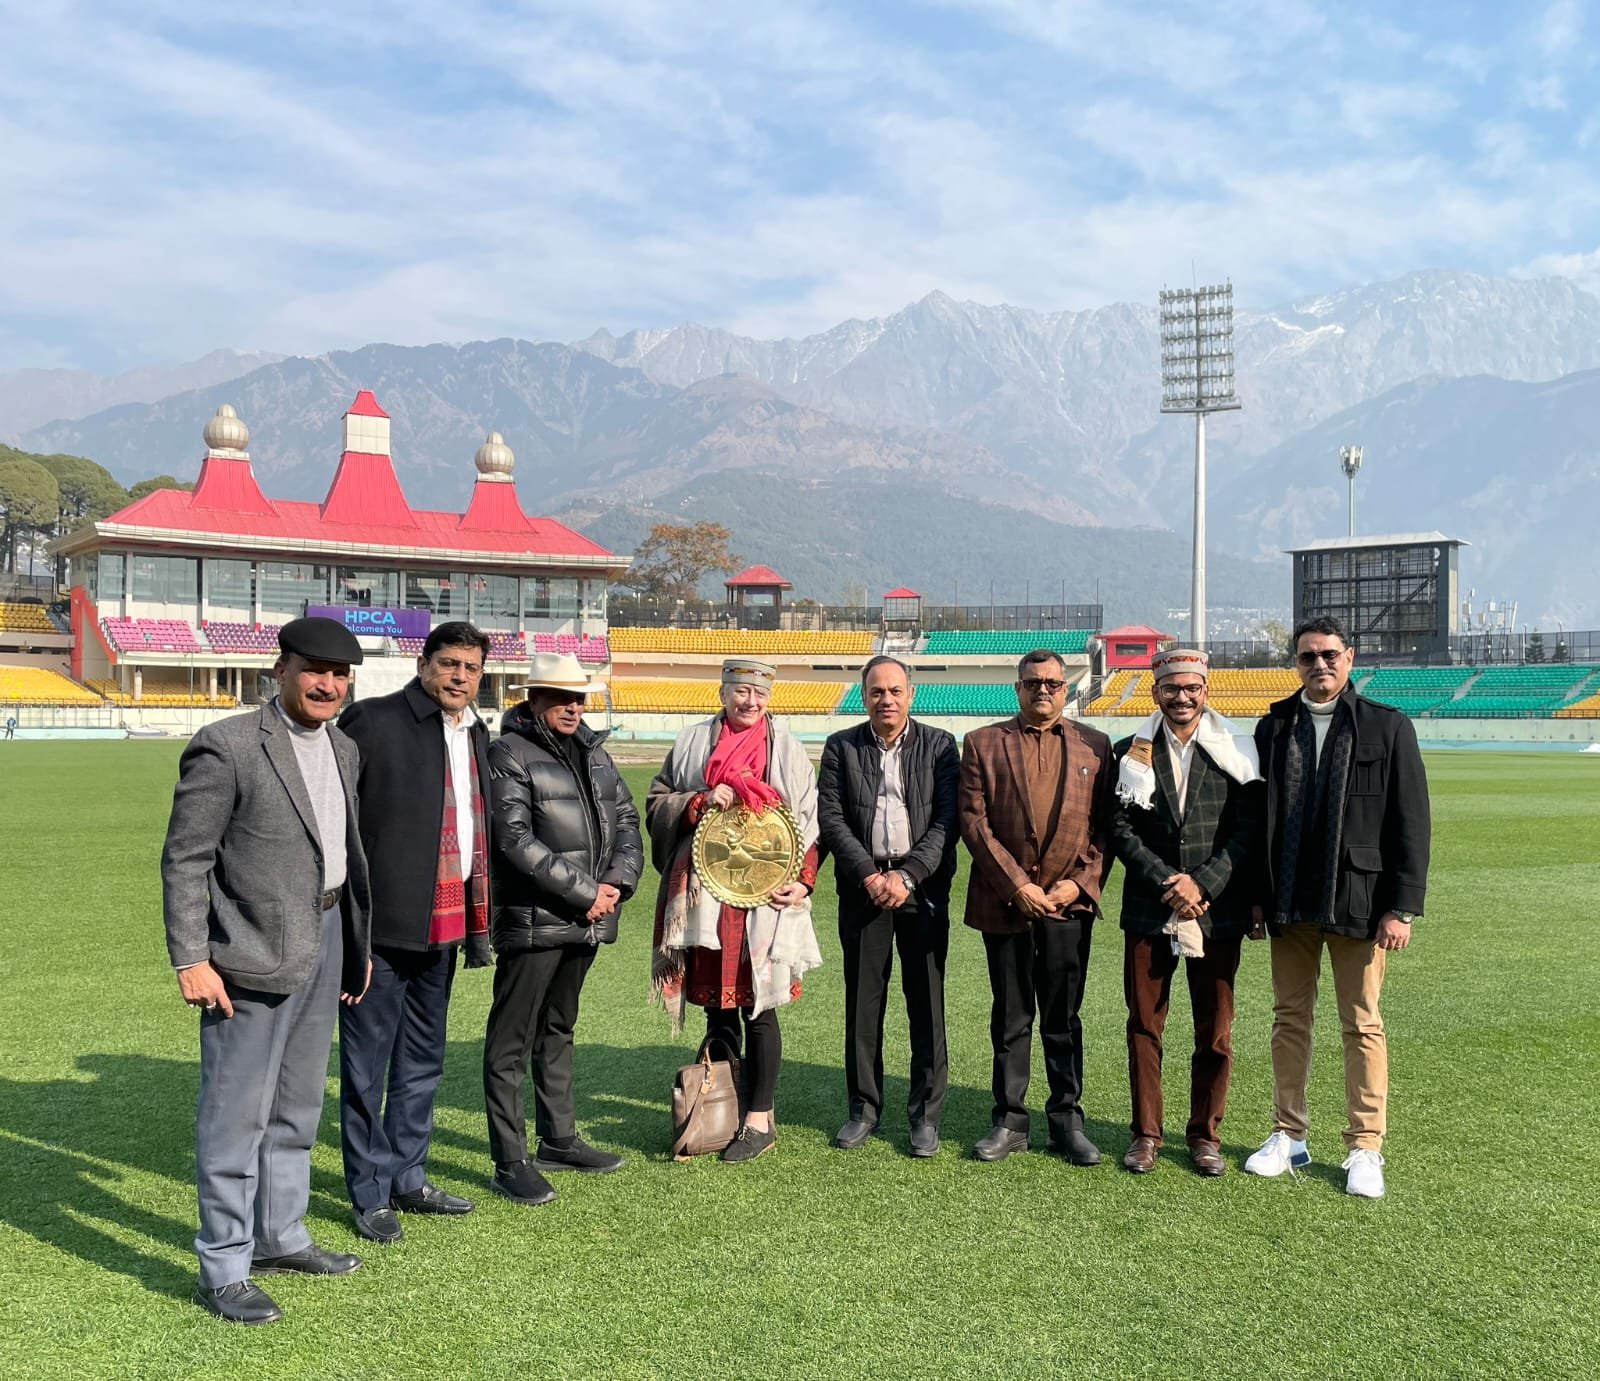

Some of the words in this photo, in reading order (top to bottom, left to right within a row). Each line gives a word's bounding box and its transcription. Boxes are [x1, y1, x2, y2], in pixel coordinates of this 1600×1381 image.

[345, 610, 396, 625] HPCA
[345, 624, 384, 633] elcomes
[386, 625, 403, 634] You
